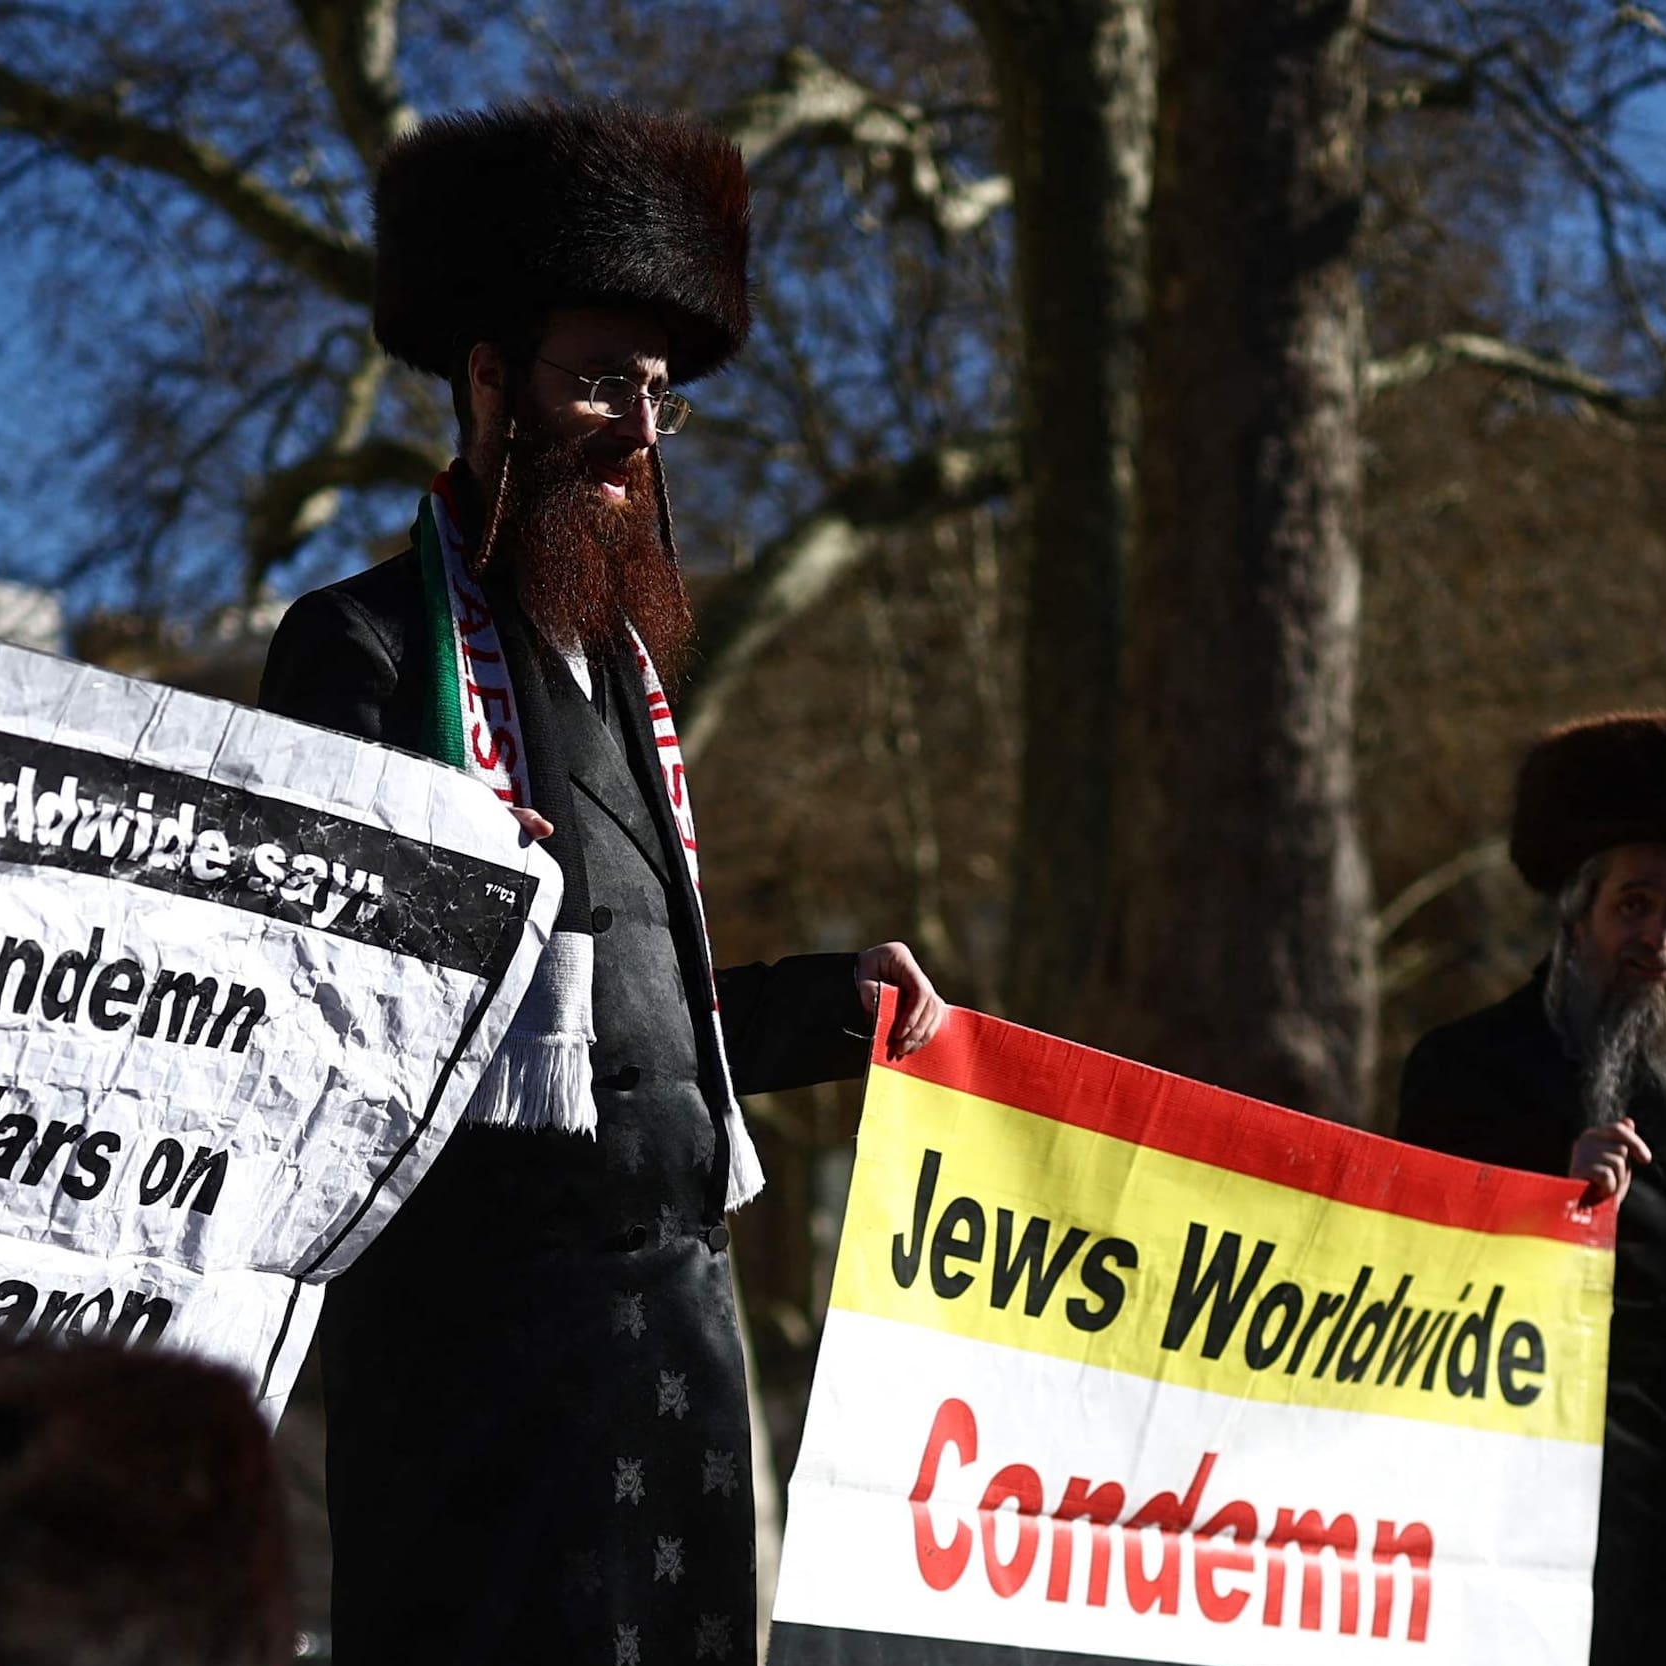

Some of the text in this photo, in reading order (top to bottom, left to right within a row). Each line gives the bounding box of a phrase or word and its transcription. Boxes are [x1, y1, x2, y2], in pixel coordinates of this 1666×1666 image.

[137, 1135, 232, 1217] on
[891, 1148, 1546, 1408] Jews Worldwide
[907, 1396, 1437, 1643] Condemn
